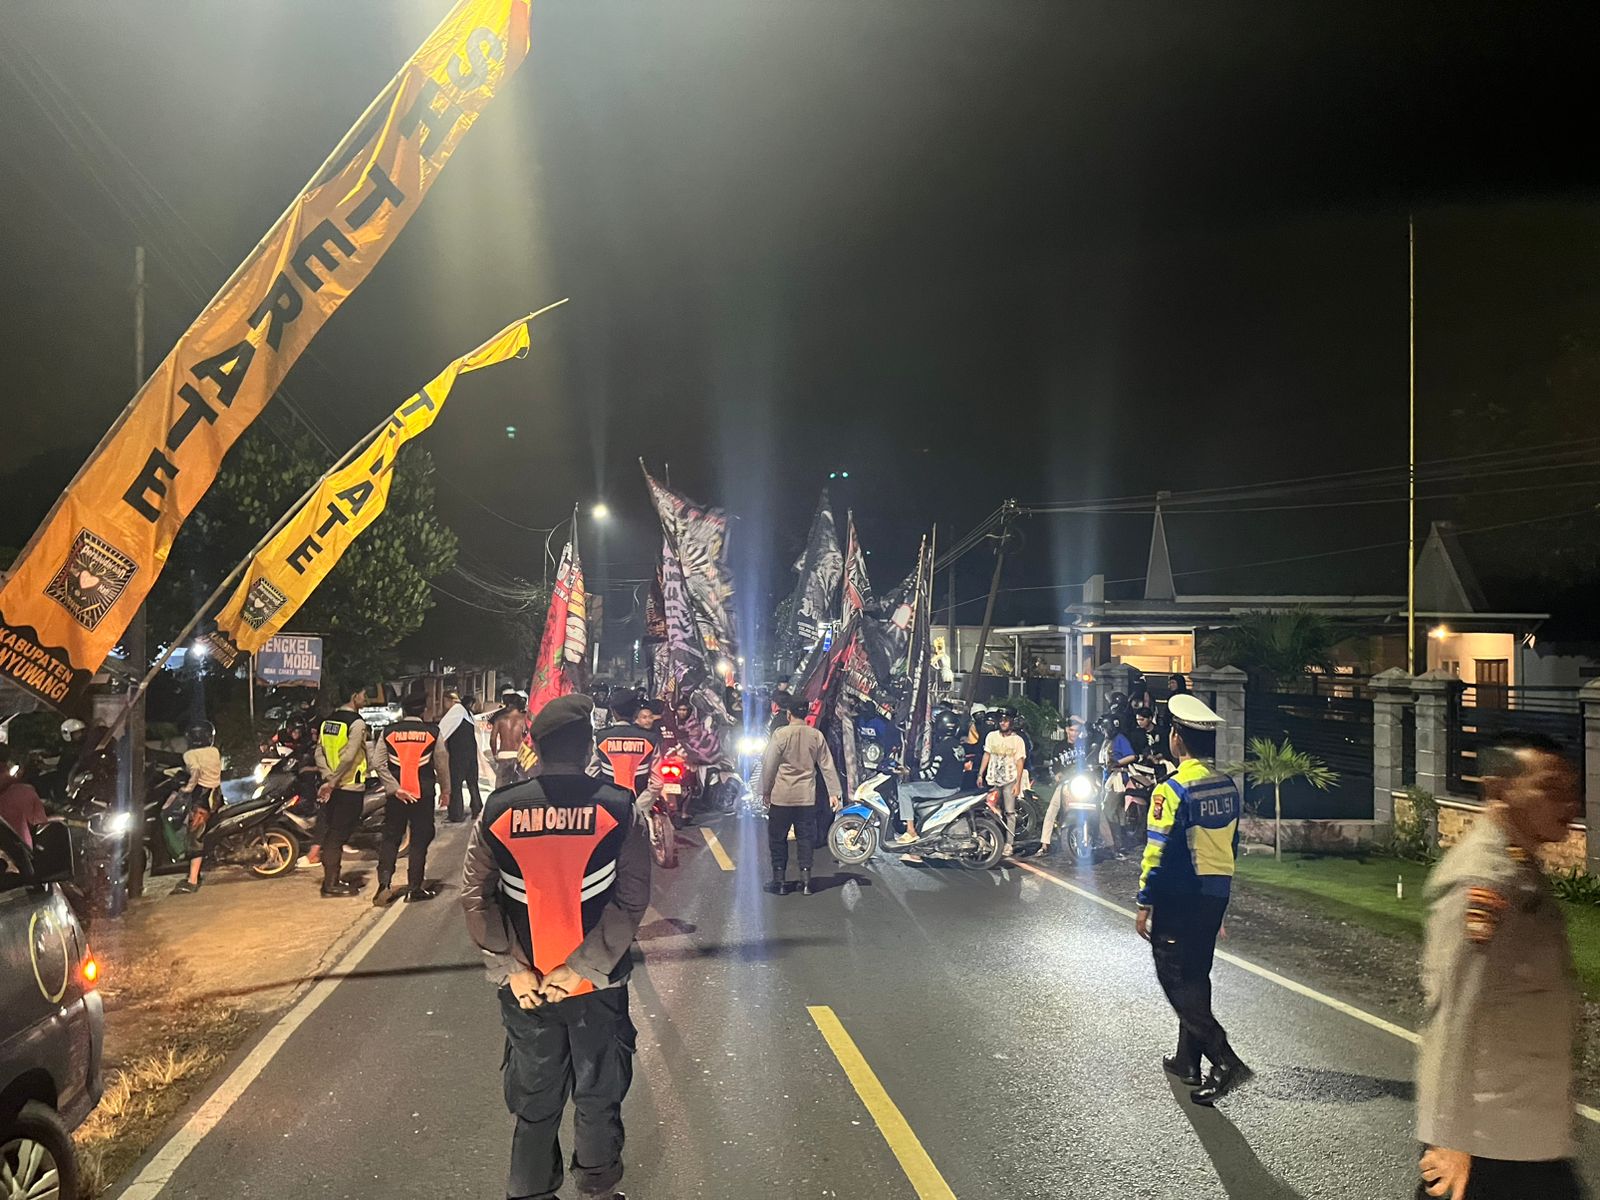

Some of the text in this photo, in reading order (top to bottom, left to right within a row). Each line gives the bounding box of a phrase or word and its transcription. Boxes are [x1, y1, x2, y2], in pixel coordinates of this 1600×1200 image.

[0, 627, 74, 683] KABUPATEN
[283, 654, 320, 670] MOBIL
[607, 740, 644, 752] PAM OBVIT
[512, 806, 593, 833] PAM OBVIT
